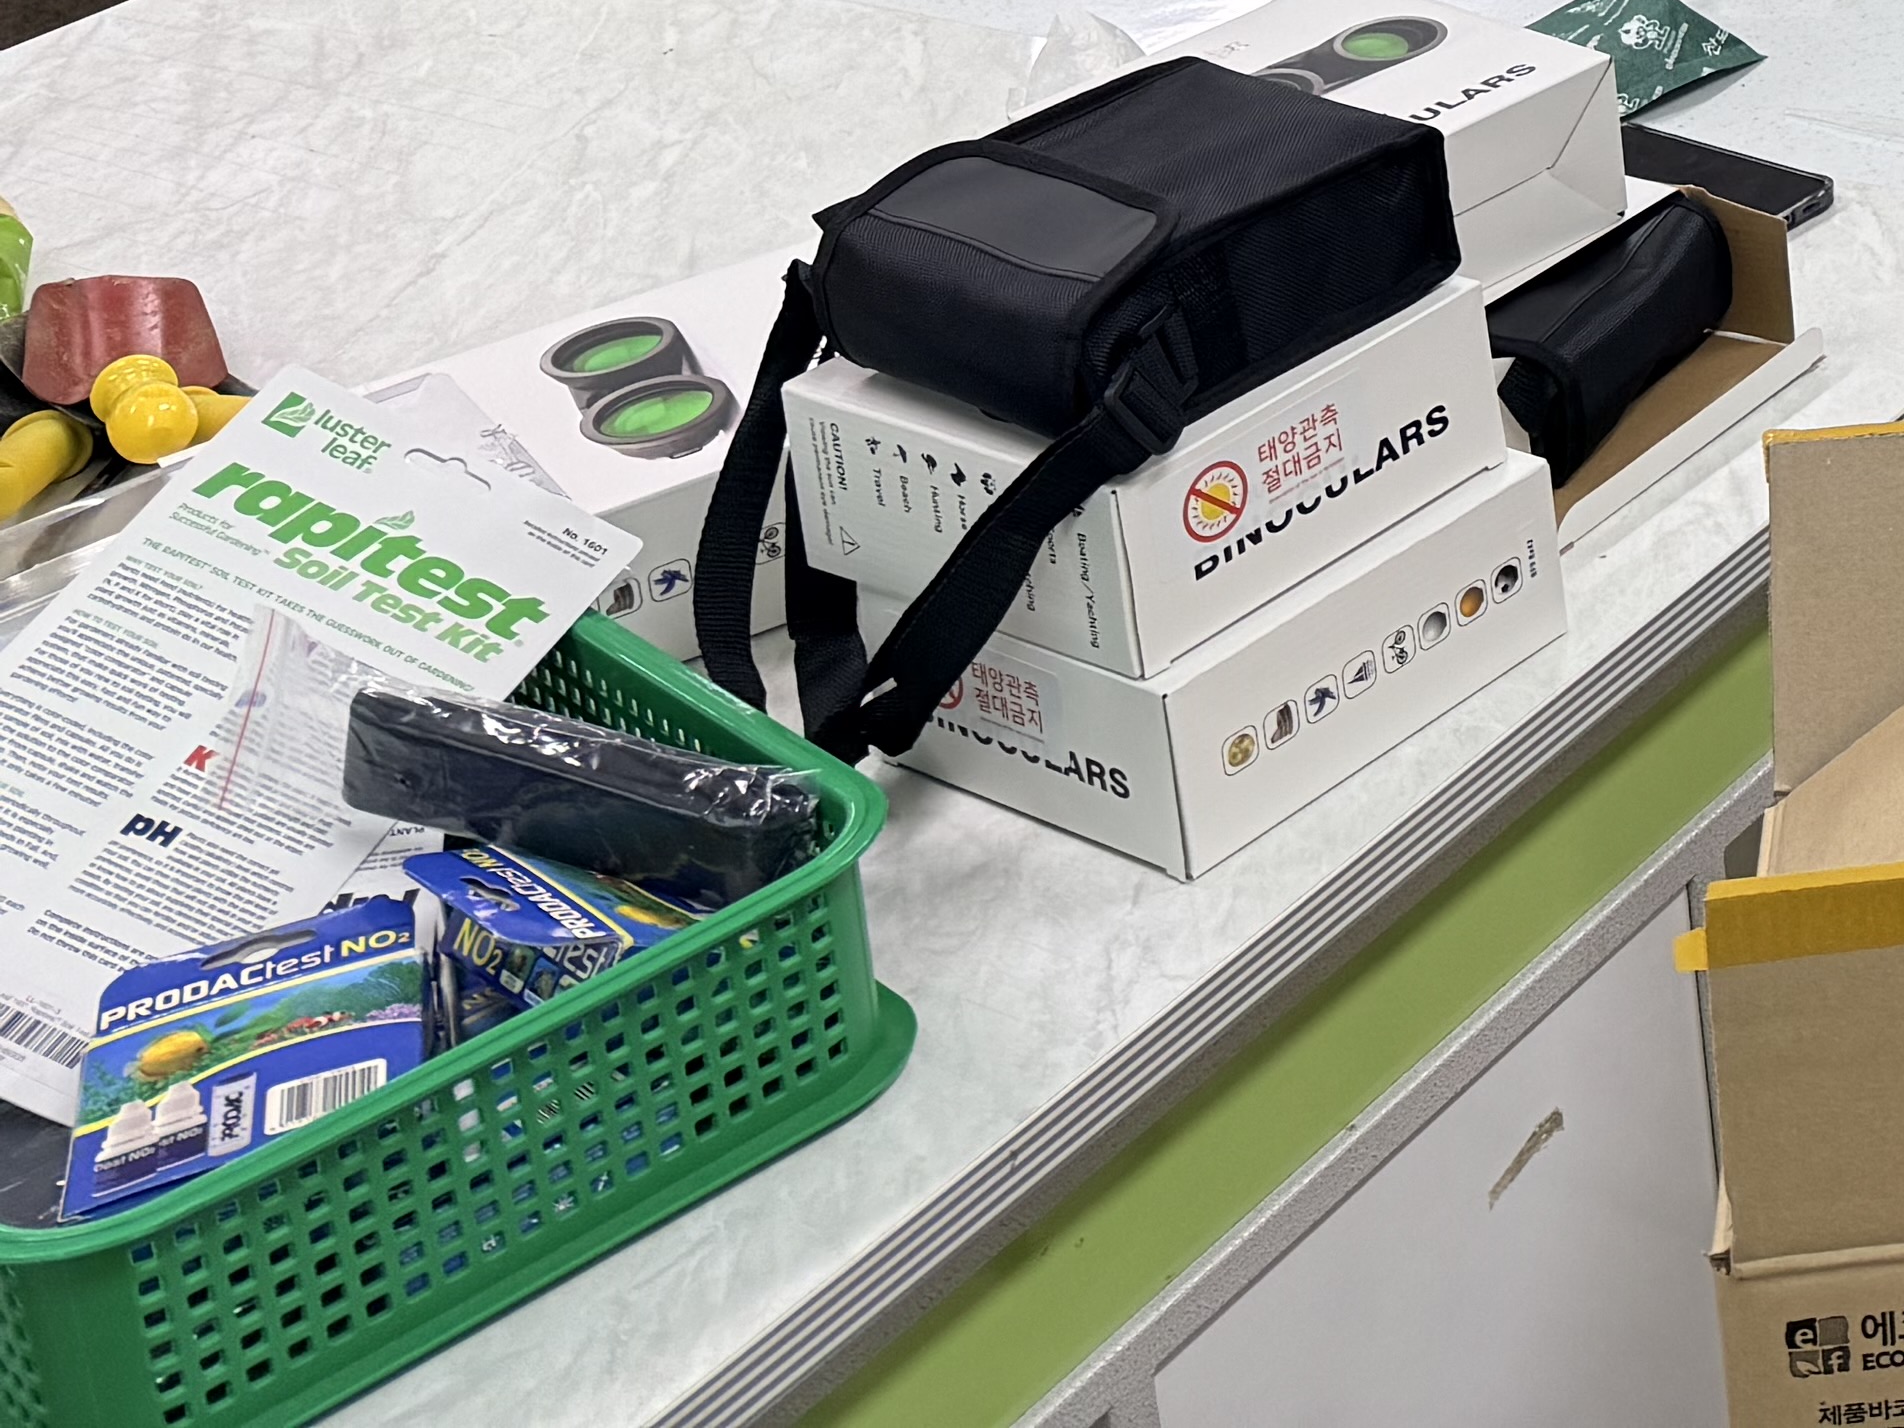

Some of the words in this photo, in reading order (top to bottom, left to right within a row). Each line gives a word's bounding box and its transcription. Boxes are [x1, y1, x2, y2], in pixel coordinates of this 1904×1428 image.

[1409, 62, 1537, 124] ULARS
[314, 408, 392, 454] luster
[1257, 403, 1341, 463] 태양관측
[320, 437, 378, 474] leaf
[829, 422, 849, 491] CAUTION!
[1261, 428, 1344, 494] 절대금지
[872, 467, 887, 508] Travel
[899, 474, 912, 514] Beach
[929, 484, 944, 534] Hunting
[192, 461, 551, 641] rapitest
[582, 537, 609, 557] 1601
[274, 546, 360, 592] Soil
[351, 579, 444, 633] Test
[434, 622, 505, 664] Kit
[971, 662, 1040, 707] 태양관측
[975, 687, 1043, 734] 절대금지
[184, 745, 218, 773] K
[120, 813, 183, 848] pH
